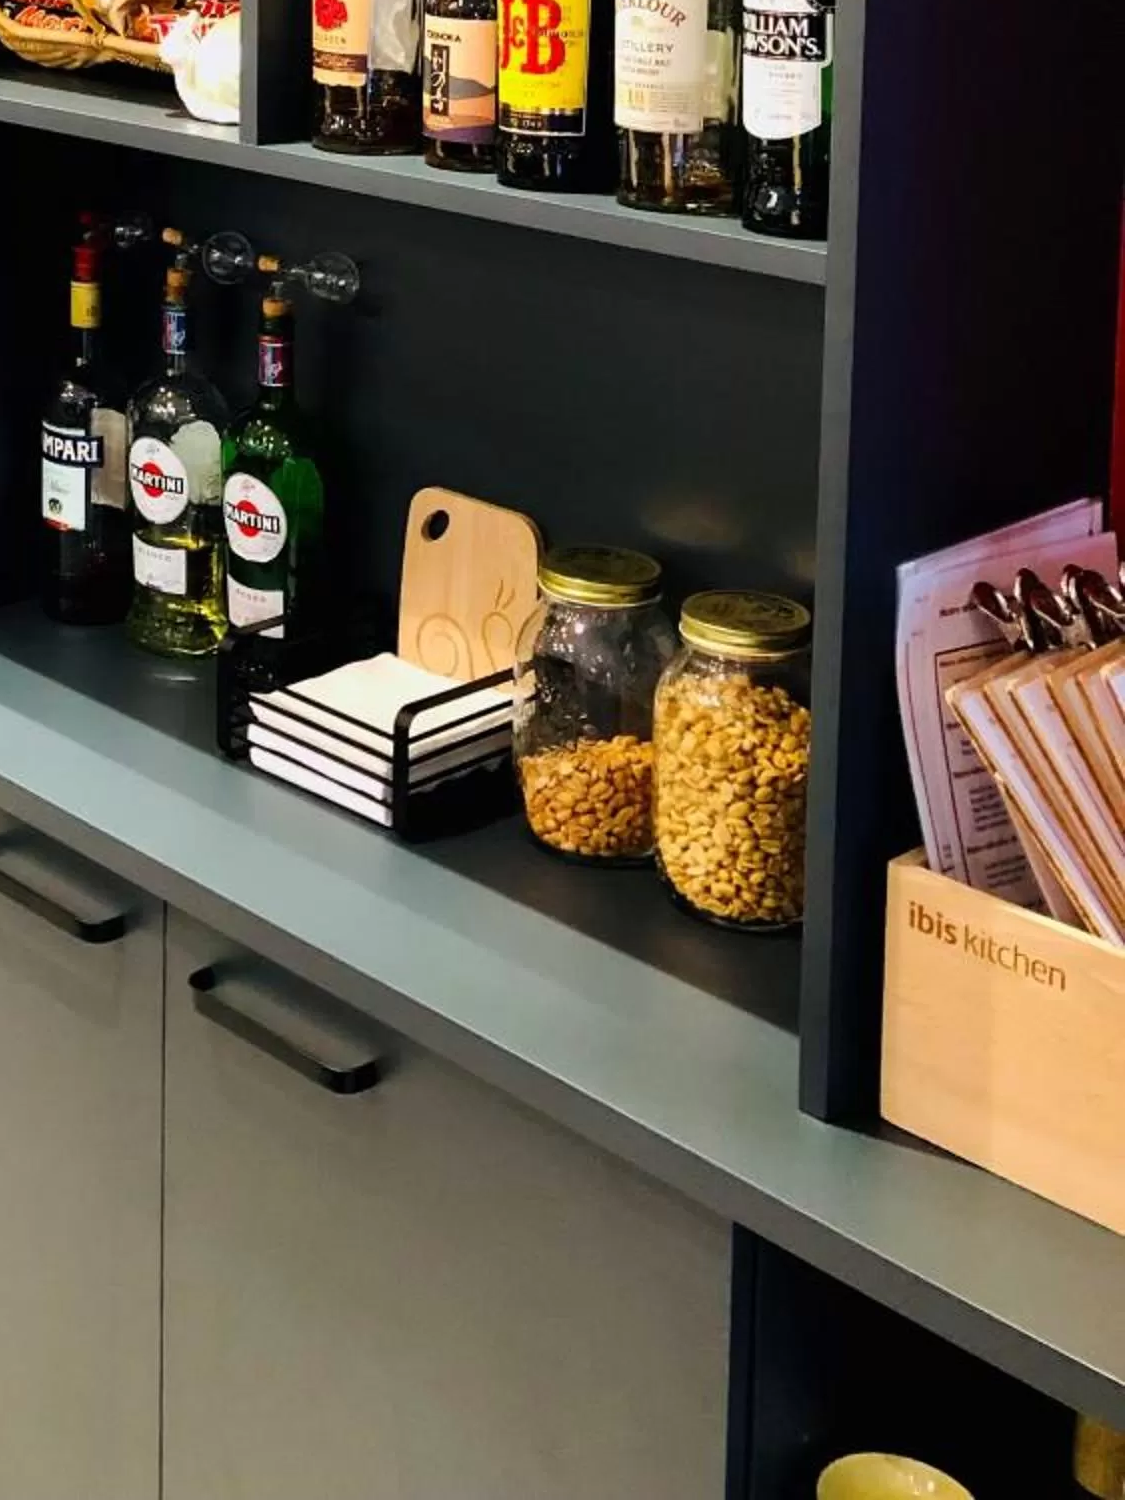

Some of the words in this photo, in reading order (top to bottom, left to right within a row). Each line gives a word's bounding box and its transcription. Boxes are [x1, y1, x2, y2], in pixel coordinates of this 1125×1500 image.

[131, 464, 184, 494] MARTINI
[226, 502, 280, 534] MARTINI
[909, 900, 958, 945] ibis
[963, 924, 1066, 992] kitchen
